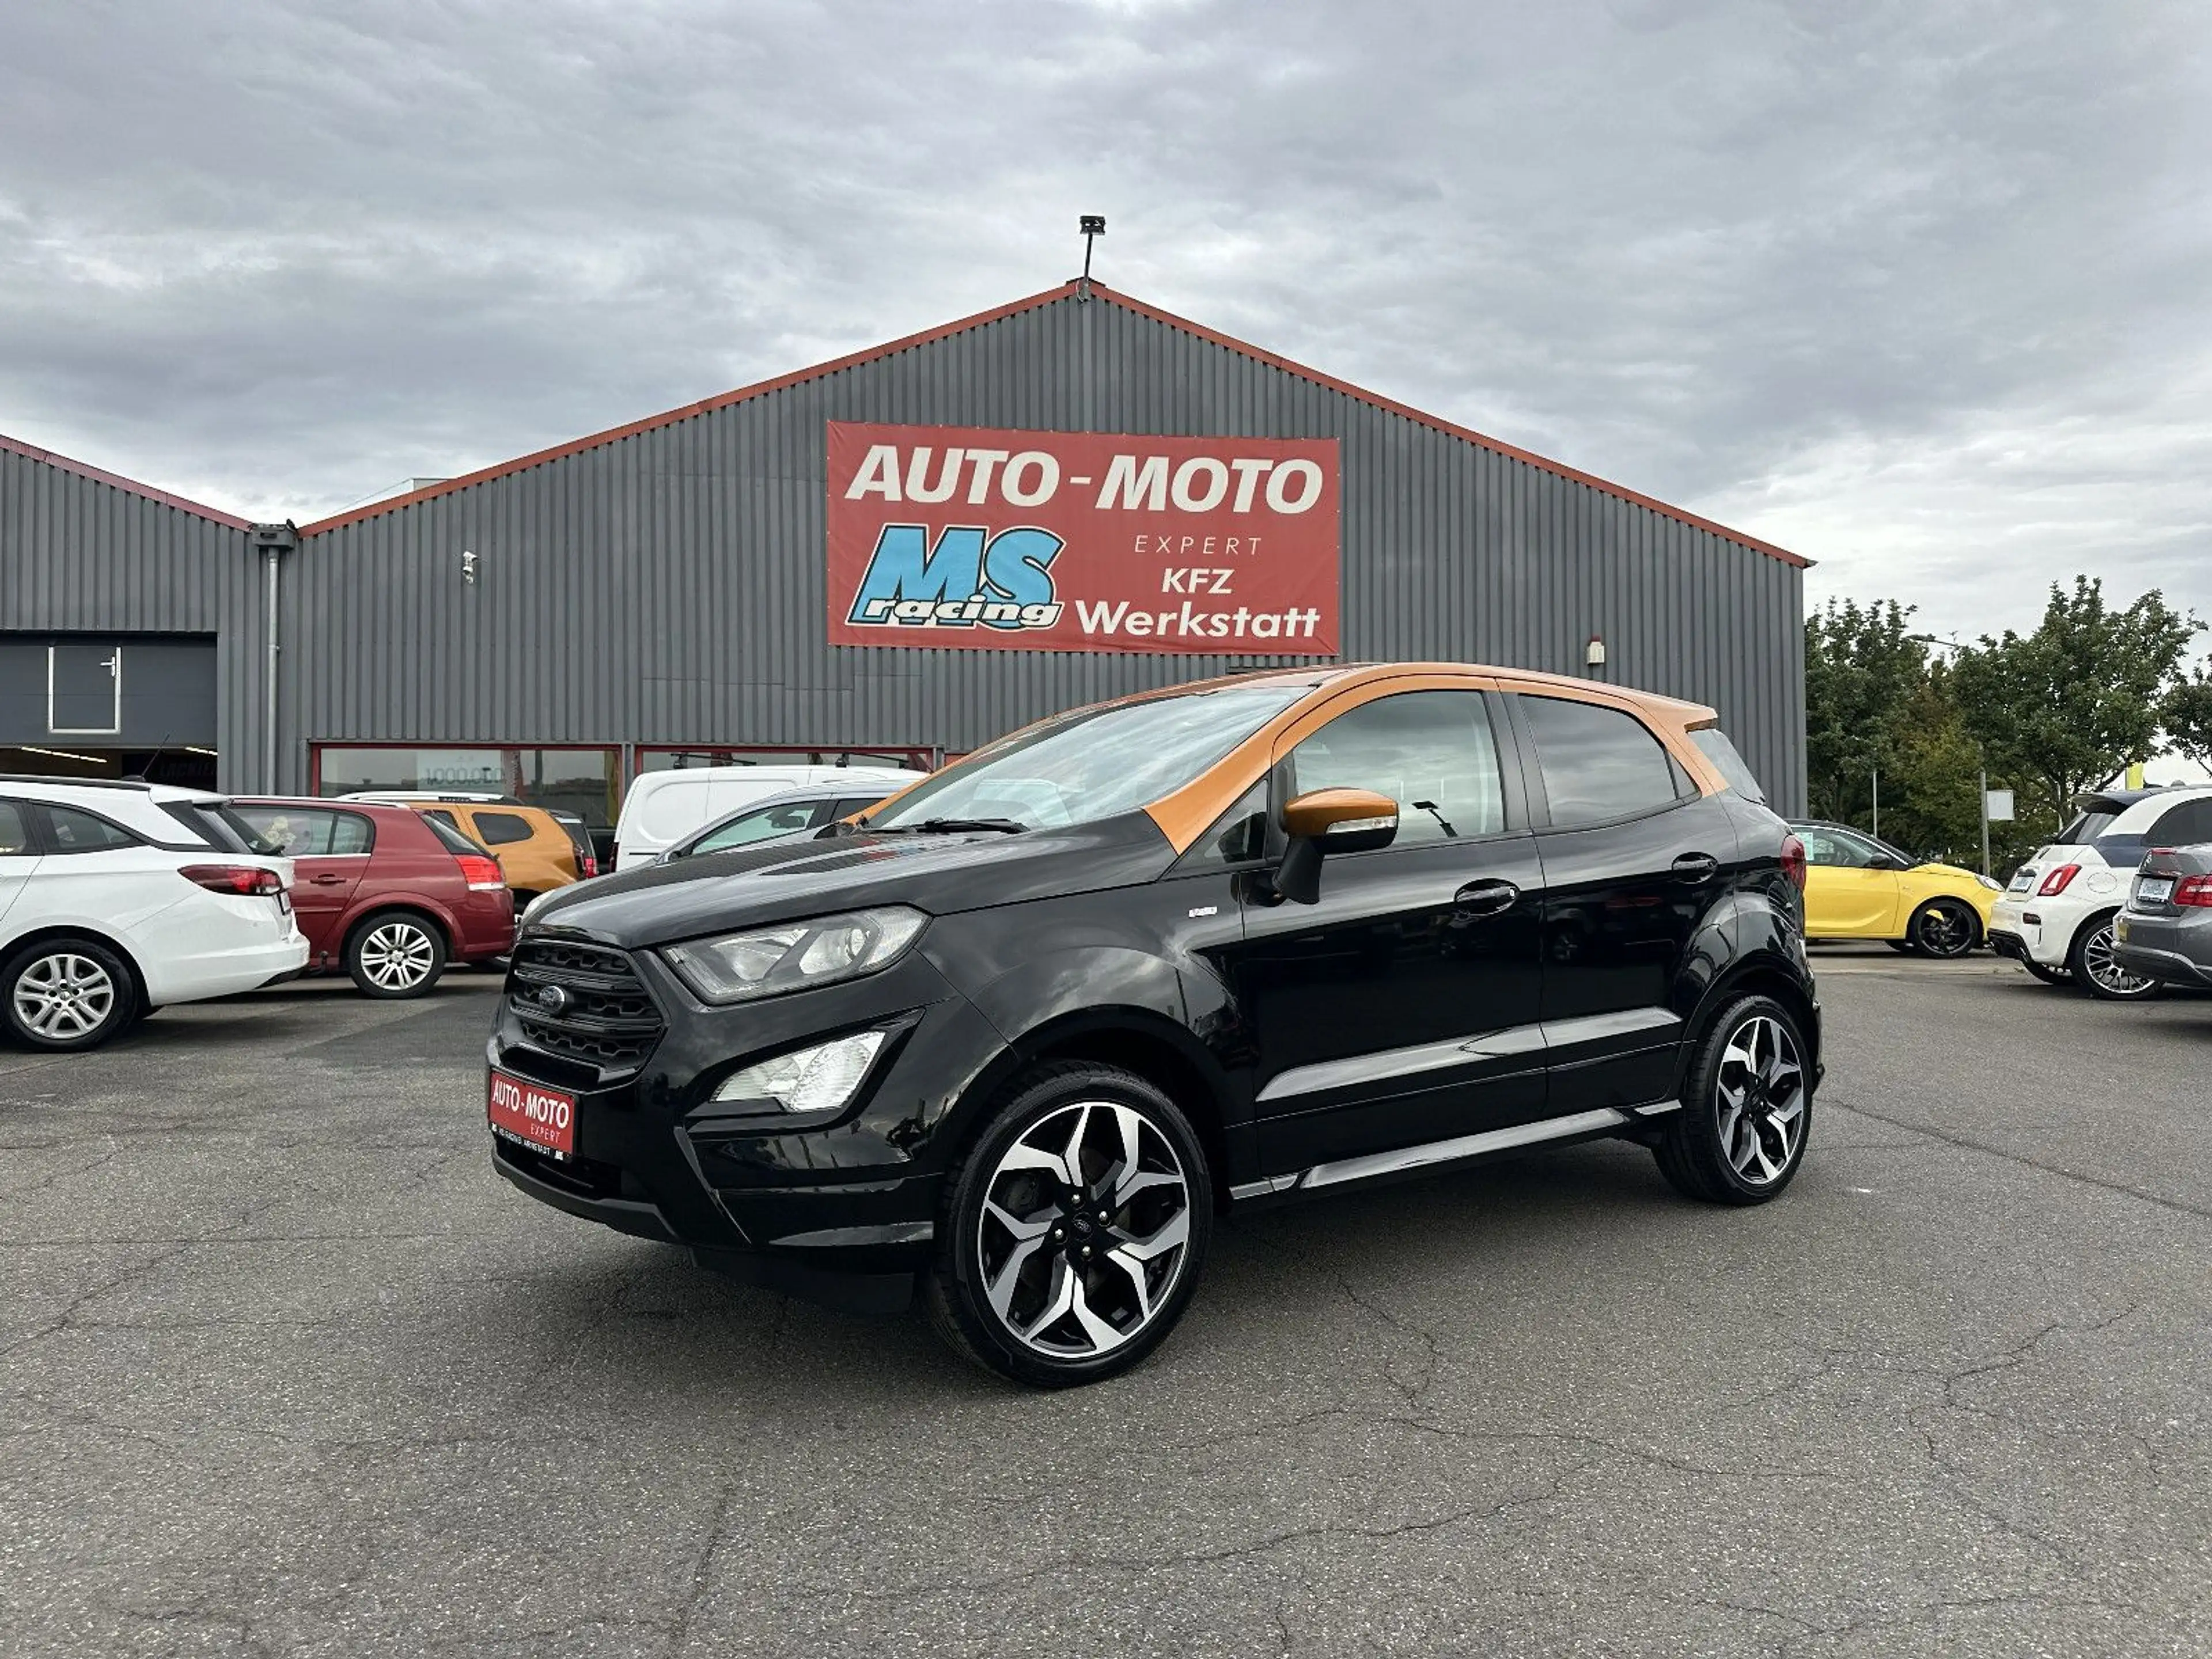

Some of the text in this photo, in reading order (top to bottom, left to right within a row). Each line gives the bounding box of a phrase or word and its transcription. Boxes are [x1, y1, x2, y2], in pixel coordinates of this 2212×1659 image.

[1134, 535, 1262, 555] EXPERT
[846, 522, 1066, 631] MS
[1161, 567, 1235, 594] KFZ
[862, 593, 1063, 628] racing
[1075, 599, 1320, 638] Werkstatt
[531, 1123, 561, 1143] EXPERT
